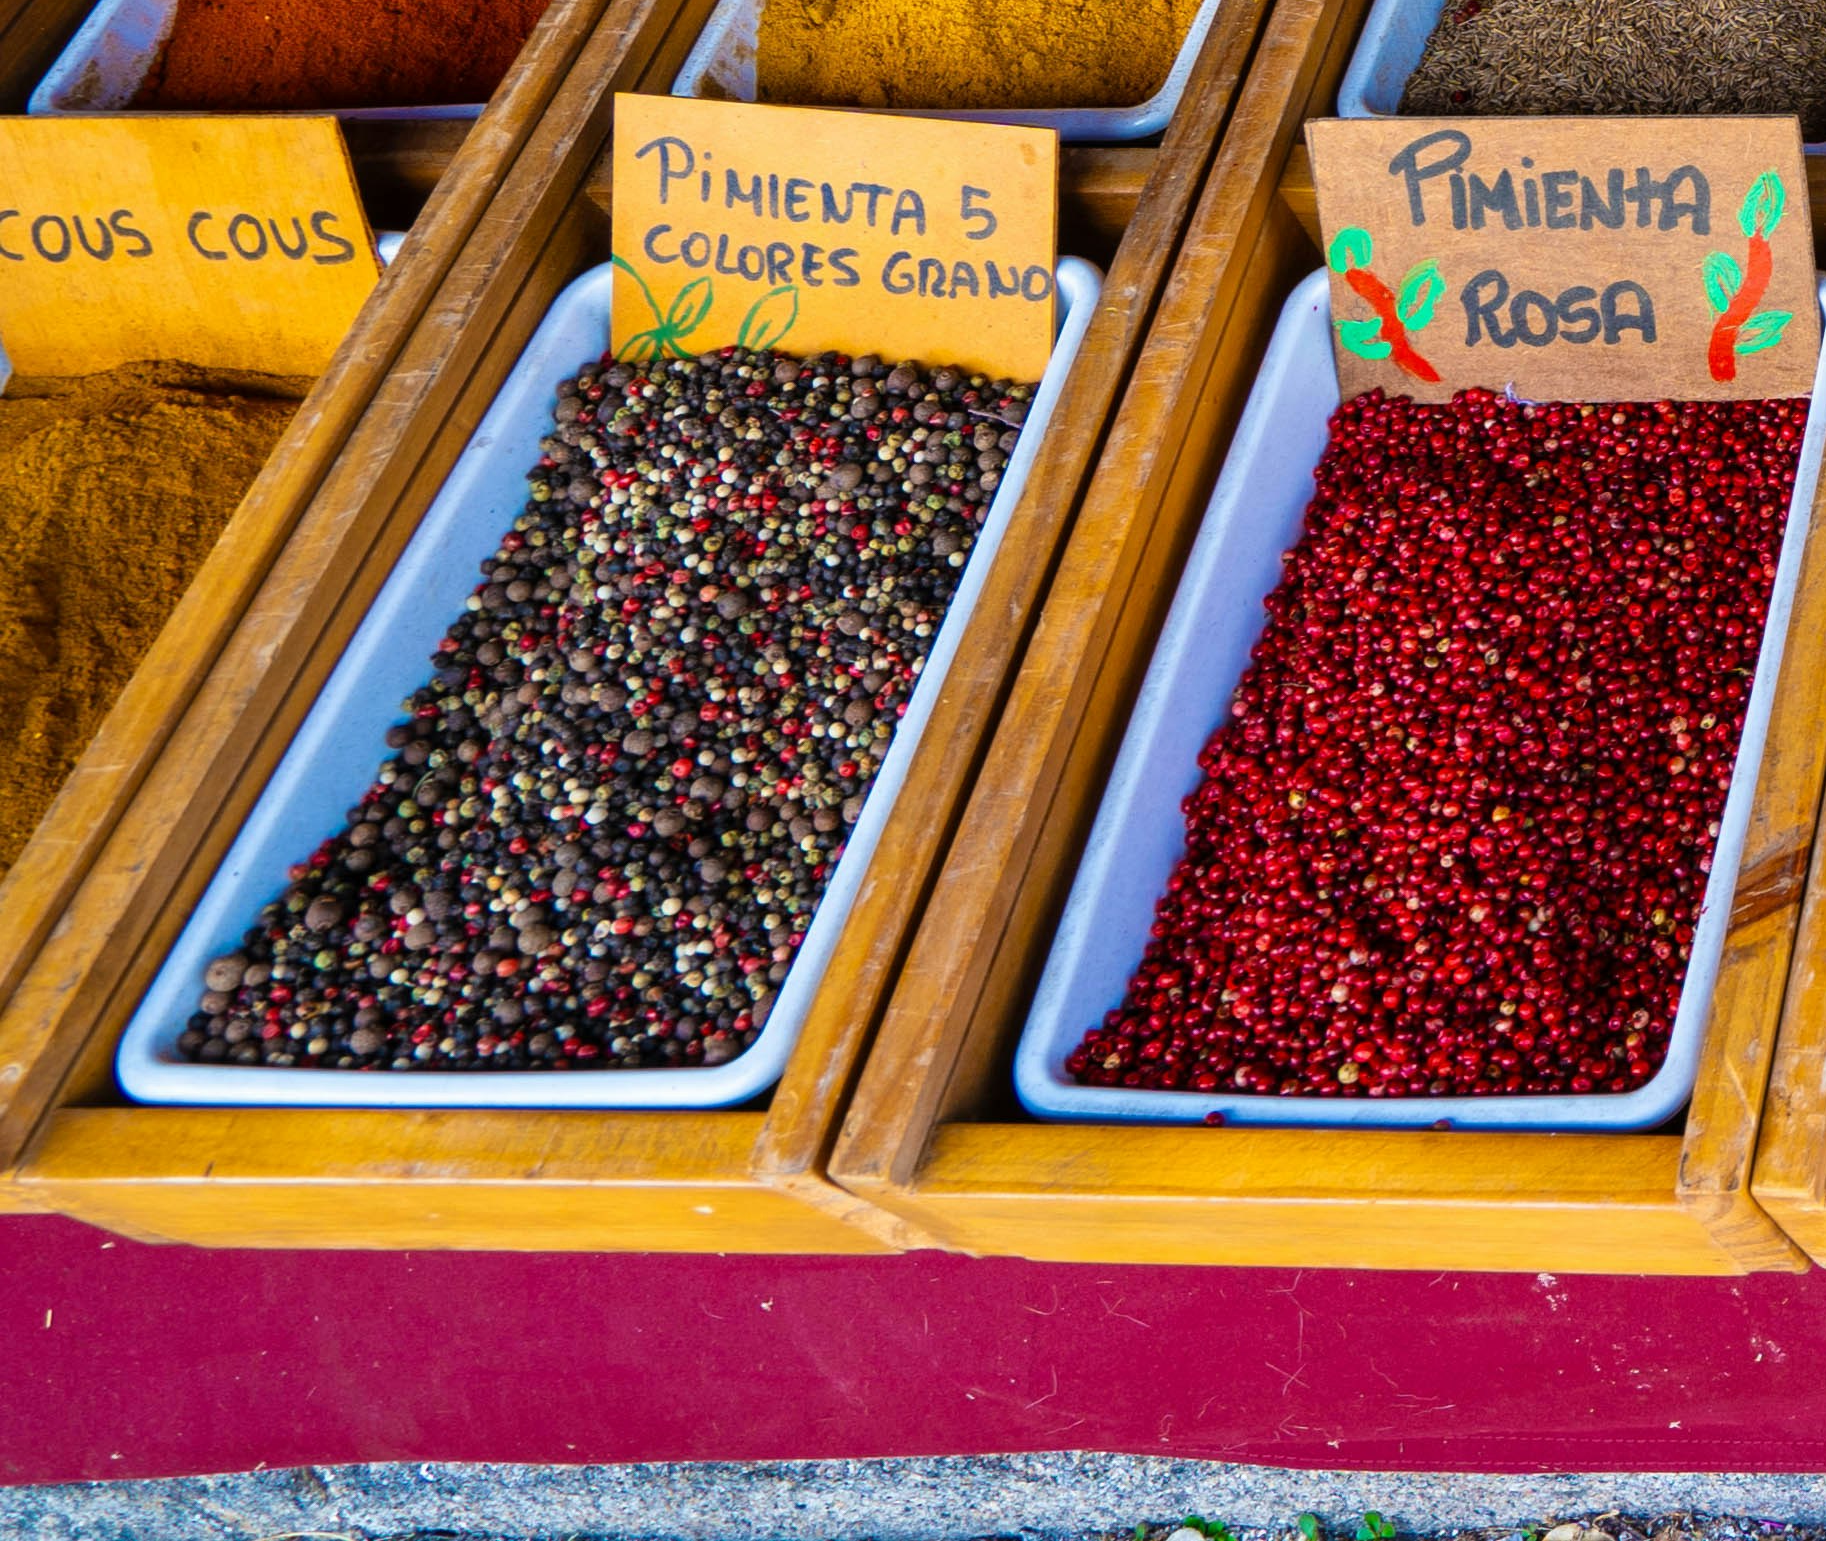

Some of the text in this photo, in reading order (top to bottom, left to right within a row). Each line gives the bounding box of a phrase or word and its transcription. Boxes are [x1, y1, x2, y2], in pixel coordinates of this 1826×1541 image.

[635, 136, 1000, 242] PIMIENTA 5
[1388, 130, 1715, 238] PIMIENTA
[0, 209, 356, 265] COUS COUS
[642, 225, 1055, 303] COLORES GRANO
[1460, 269, 1659, 352] ROSA
